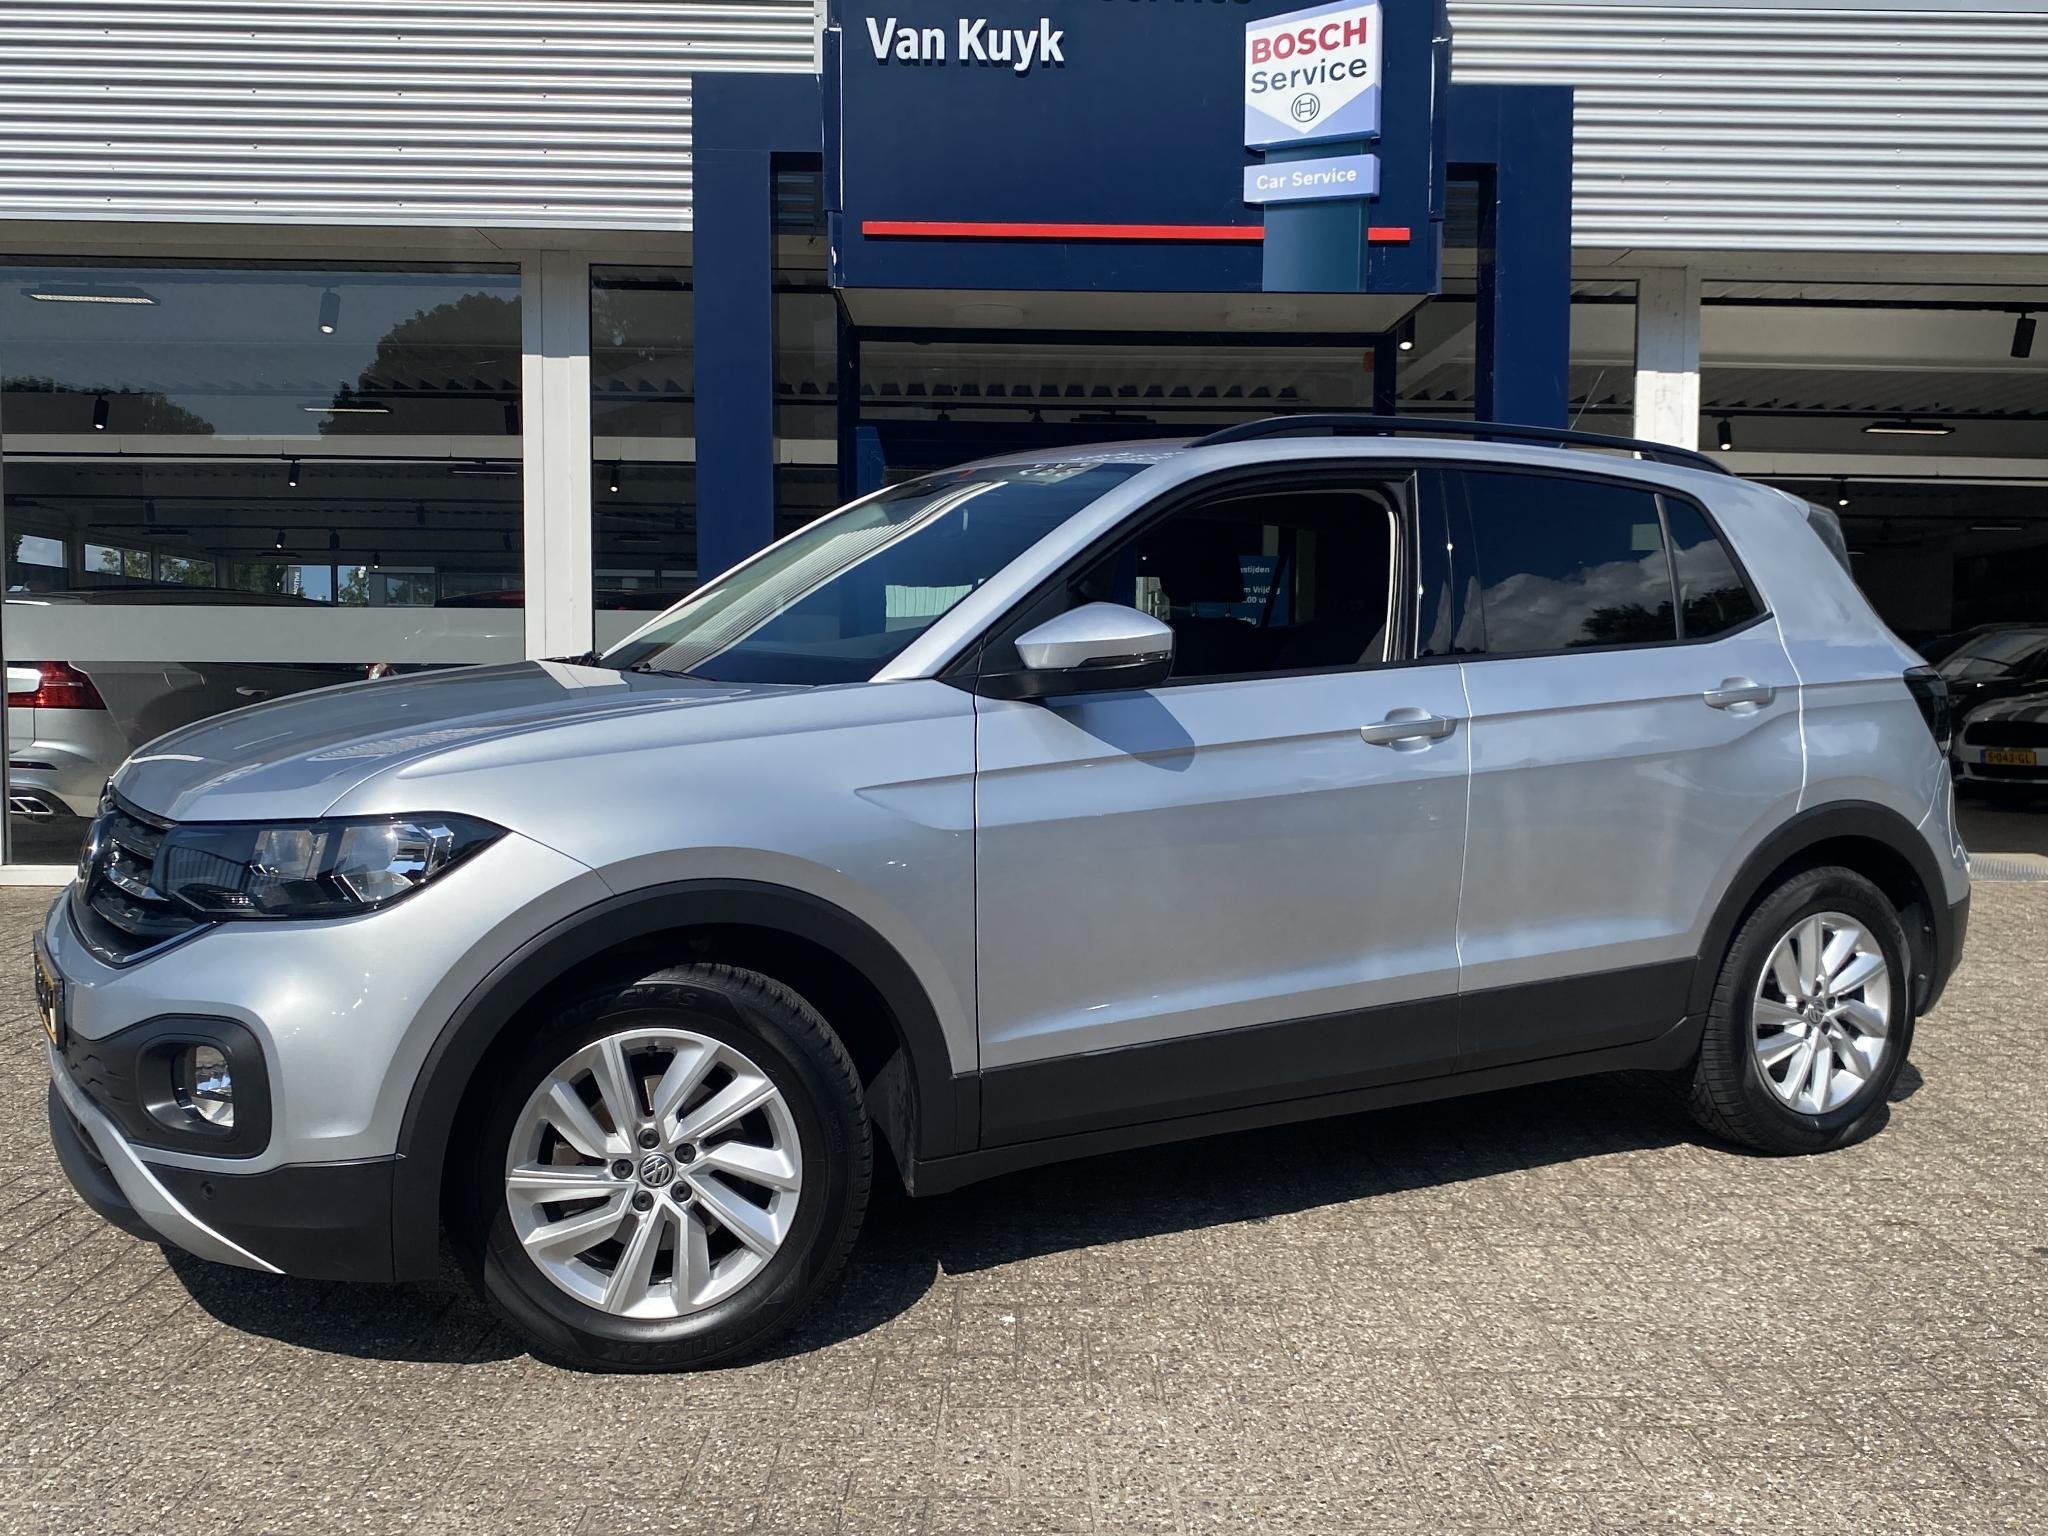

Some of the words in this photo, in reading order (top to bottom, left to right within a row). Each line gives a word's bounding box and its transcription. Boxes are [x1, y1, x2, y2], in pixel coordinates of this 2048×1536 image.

[866, 17, 945, 60] Van
[958, 17, 1065, 72] Kuyk
[1252, 16, 1367, 65] BOSCH
[1251, 58, 1367, 94] Service
[1256, 175, 1286, 190] Car
[1292, 168, 1357, 187] Service
